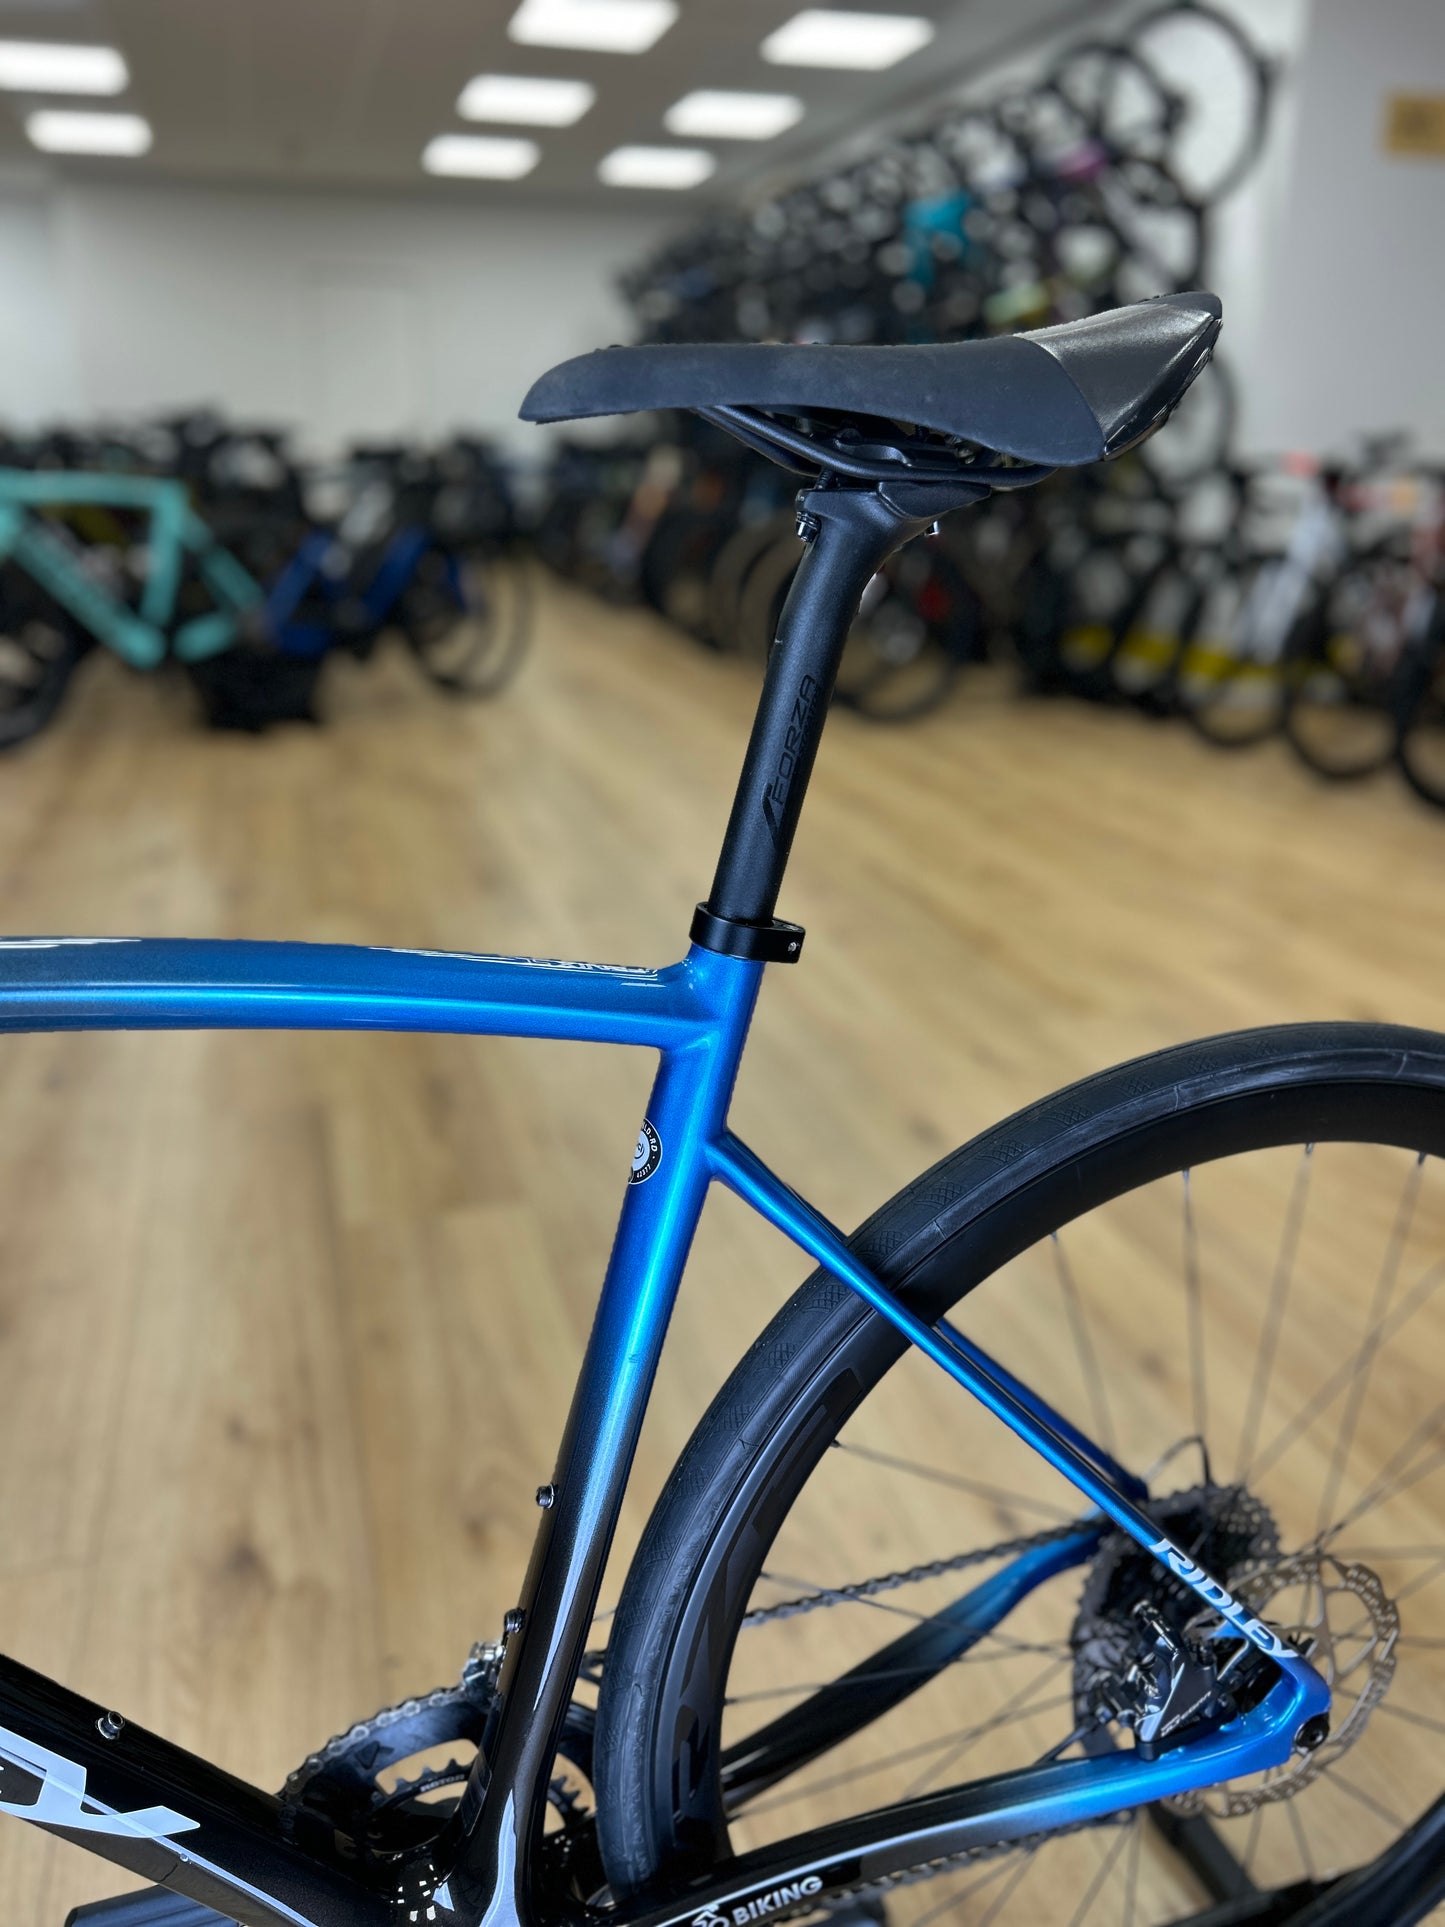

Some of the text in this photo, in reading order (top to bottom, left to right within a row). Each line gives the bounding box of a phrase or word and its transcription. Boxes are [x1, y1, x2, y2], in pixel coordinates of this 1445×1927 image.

[771, 674, 816, 805] FORZA
[1148, 1538, 1299, 1658] RIDLEY
[732, 1875, 824, 1926] BIKING
